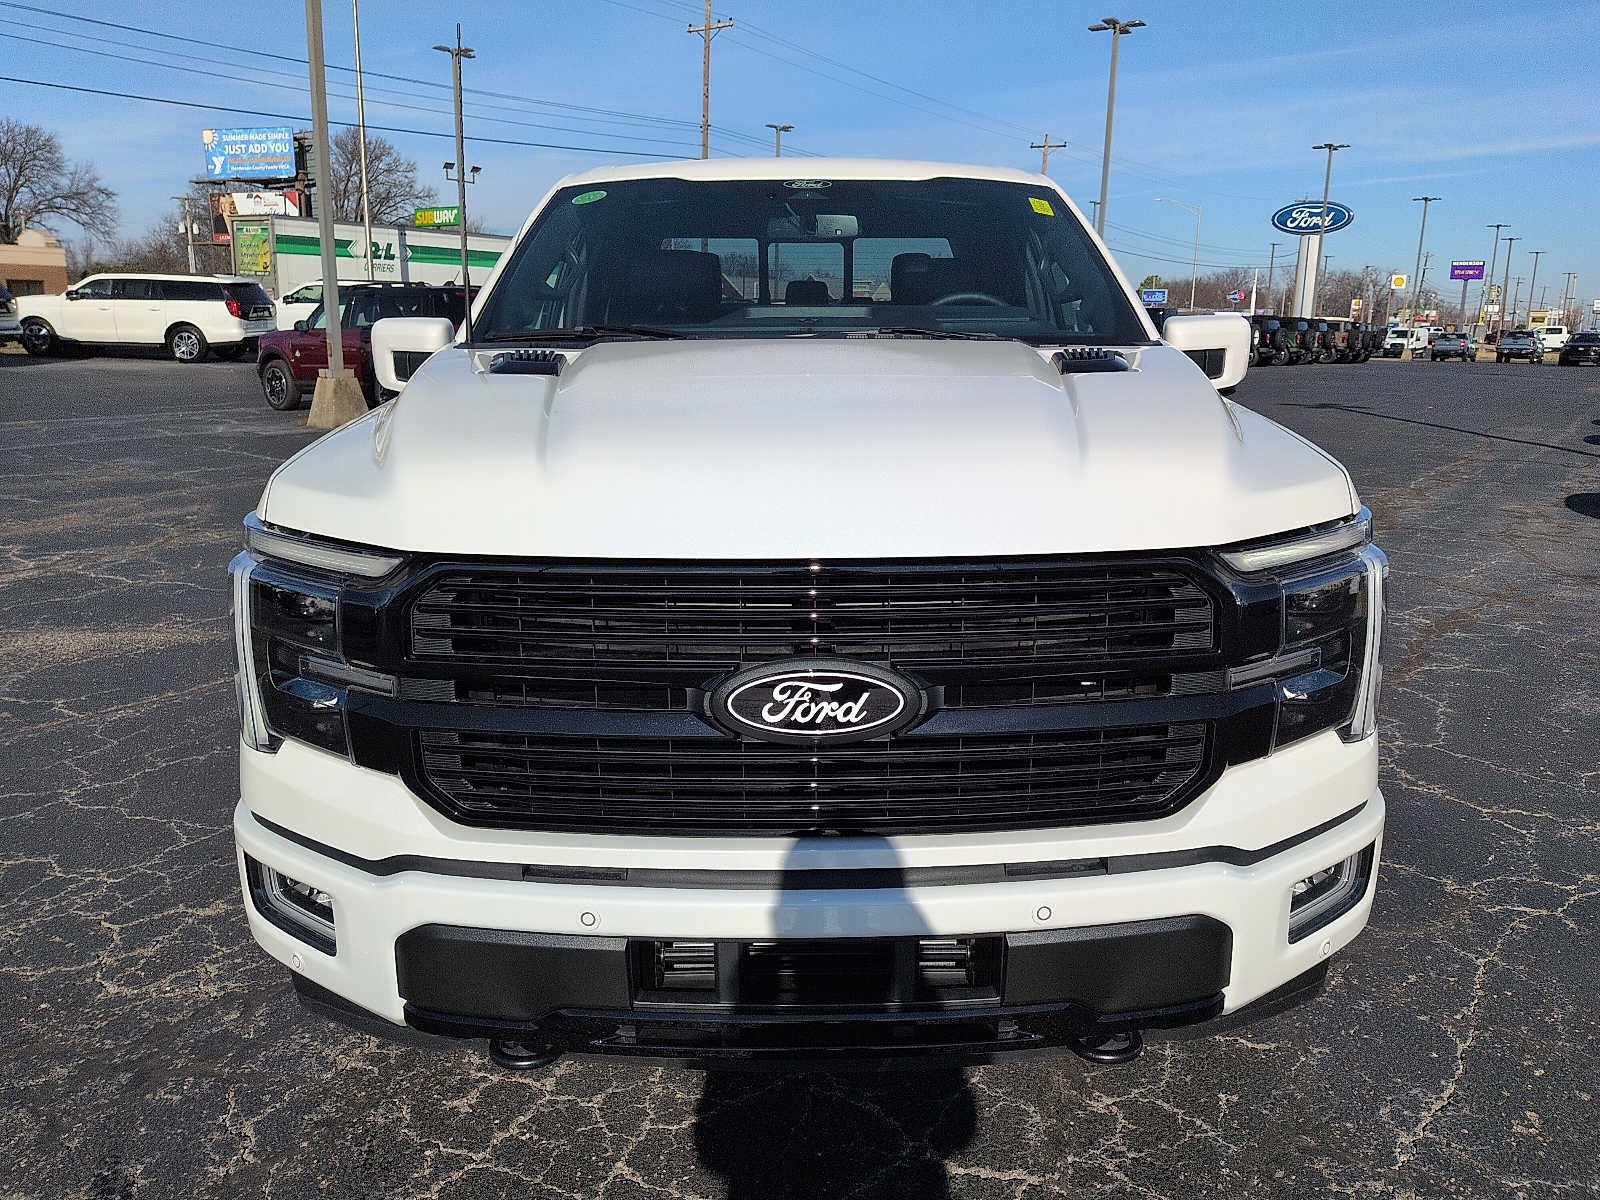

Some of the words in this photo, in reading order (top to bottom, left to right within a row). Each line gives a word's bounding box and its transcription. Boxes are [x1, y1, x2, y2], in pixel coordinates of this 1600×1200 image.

[222, 134, 248, 142] SUMMER
[249, 133, 265, 141] MADE
[267, 132, 289, 140] SIMPLE
[224, 144, 247, 154] JUST
[248, 143, 267, 154] ADD
[269, 142, 289, 153] YOU
[415, 208, 458, 224] SUBWAY
[1286, 207, 1336, 228] Ford
[761, 680, 871, 724] Ford
